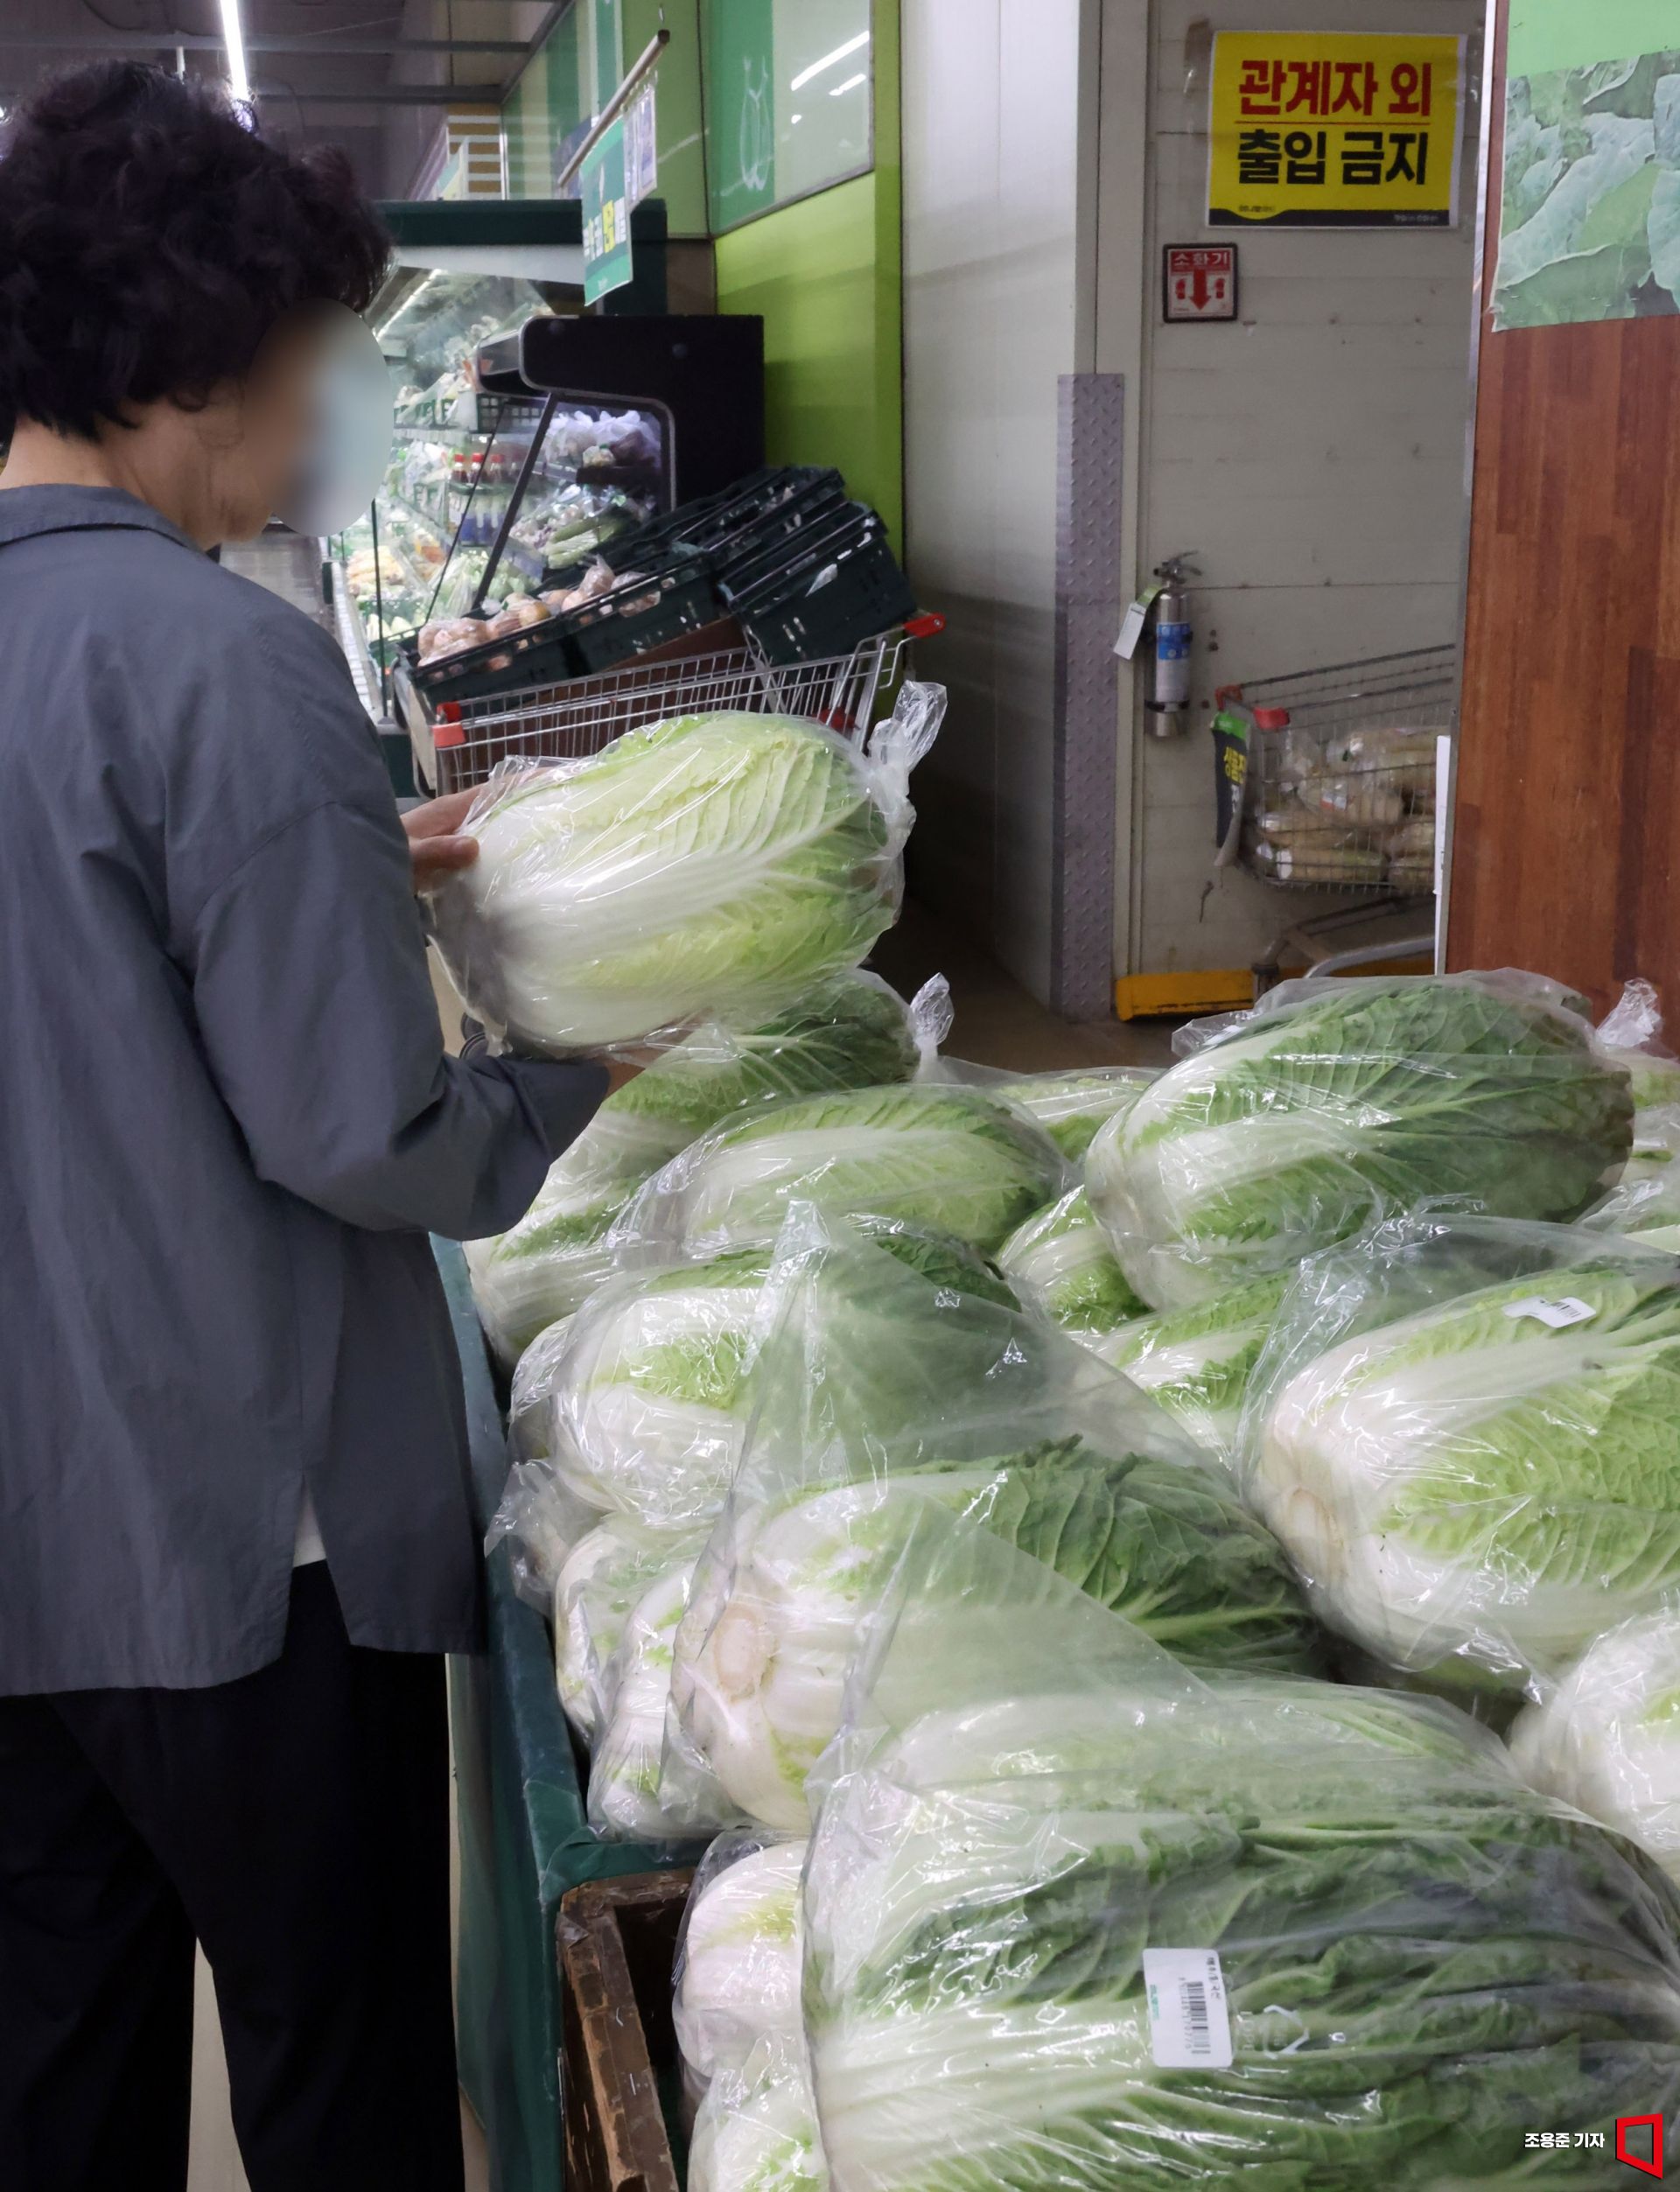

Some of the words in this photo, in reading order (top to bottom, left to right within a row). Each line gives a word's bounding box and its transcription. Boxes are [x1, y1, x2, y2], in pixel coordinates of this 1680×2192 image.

[1238, 60, 1379, 116] 관계자
[1388, 62, 1432, 116] 외
[1237, 129, 1326, 185] 출입
[1340, 131, 1428, 186] 금지
[1174, 252, 1228, 266] 소화기
